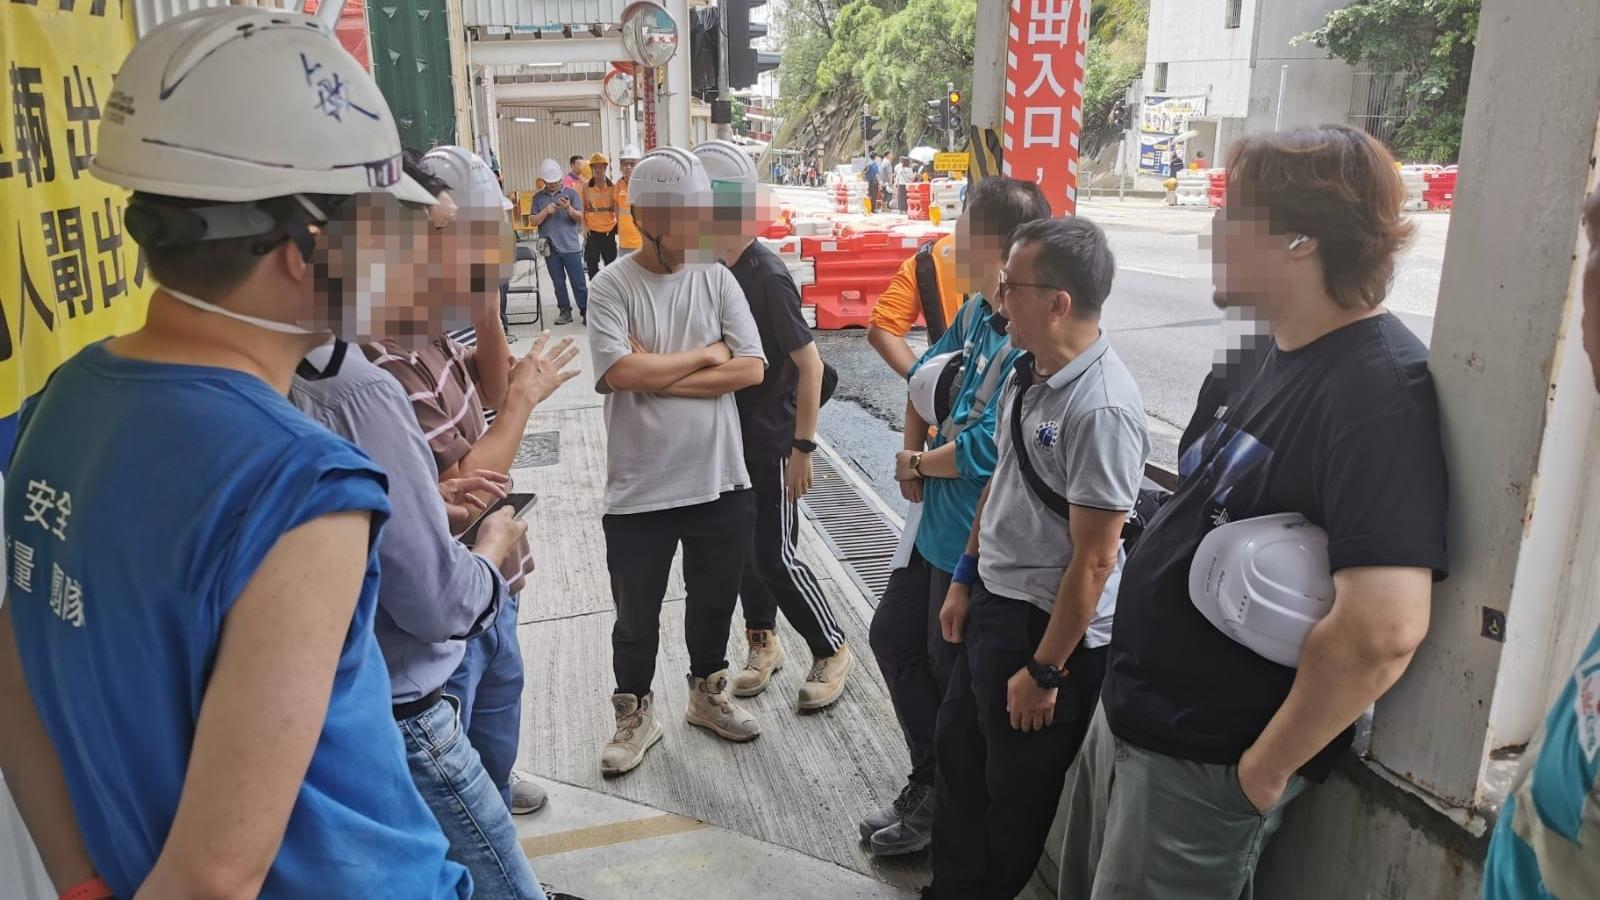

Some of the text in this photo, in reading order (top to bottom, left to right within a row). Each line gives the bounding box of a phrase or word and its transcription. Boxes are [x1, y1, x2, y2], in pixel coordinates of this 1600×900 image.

[0, 61, 119, 188] 輛出
[0, 197, 145, 362] 人閘出
[24, 479, 72, 542] 安全
